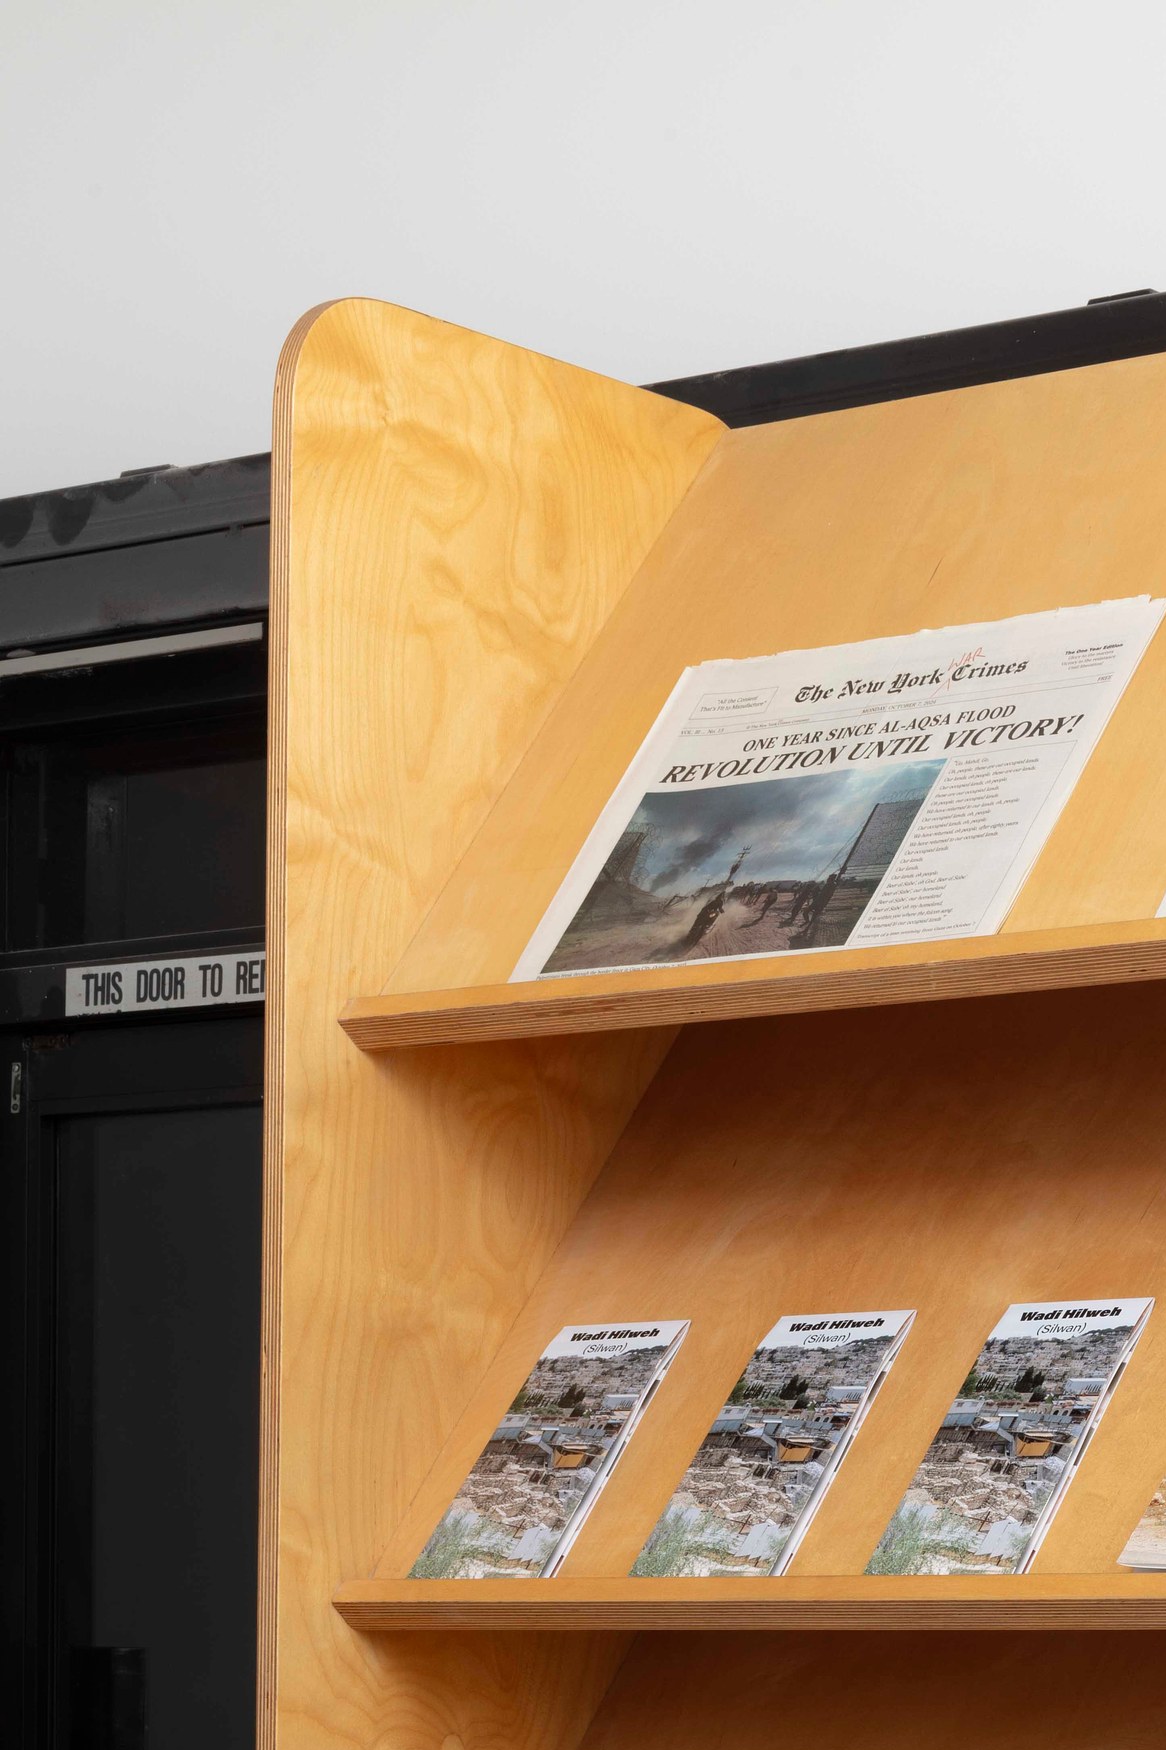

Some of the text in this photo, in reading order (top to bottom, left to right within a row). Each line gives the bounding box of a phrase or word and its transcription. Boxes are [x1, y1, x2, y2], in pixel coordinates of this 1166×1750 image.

[795, 660, 1029, 703] The New York Crimes
[743, 740, 777, 752] ONE
[780, 733, 822, 747] YEAR
[825, 723, 876, 741] SINCE
[879, 713, 951, 734] AL-AQSA
[956, 705, 1016, 724] FLOOD
[660, 714, 1084, 783] REVOLUTION UNTIL VICTORY!
[82, 971, 123, 1007] THIS
[136, 967, 186, 1003] DOOR
[199, 963, 223, 998] TO
[1020, 1307, 1122, 1321] Wadi Hilweh
[789, 1318, 885, 1332] Wadi Hilweh
[1037, 1323, 1086, 1335] (Silwan)
[571, 1328, 660, 1341] Wadi Hilweh
[803, 1333, 850, 1345] (Silwan)
[583, 1343, 627, 1354] (Silwan)
